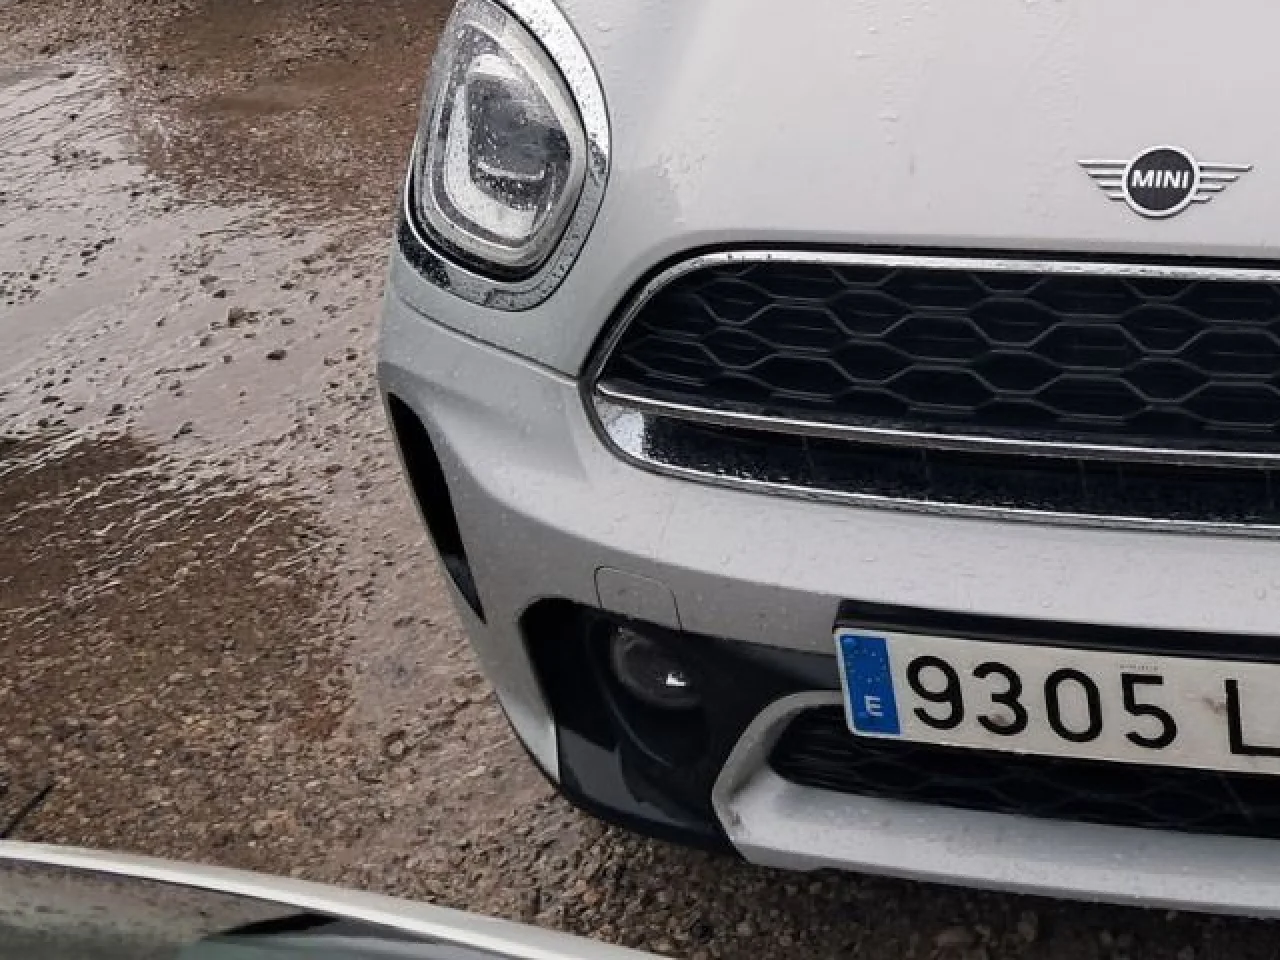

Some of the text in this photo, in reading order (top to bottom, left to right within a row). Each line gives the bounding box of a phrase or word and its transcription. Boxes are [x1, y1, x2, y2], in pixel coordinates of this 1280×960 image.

[1131, 169, 1190, 189] MINI
[864, 695, 885, 717] E
[905, 654, 1179, 750] 9305
